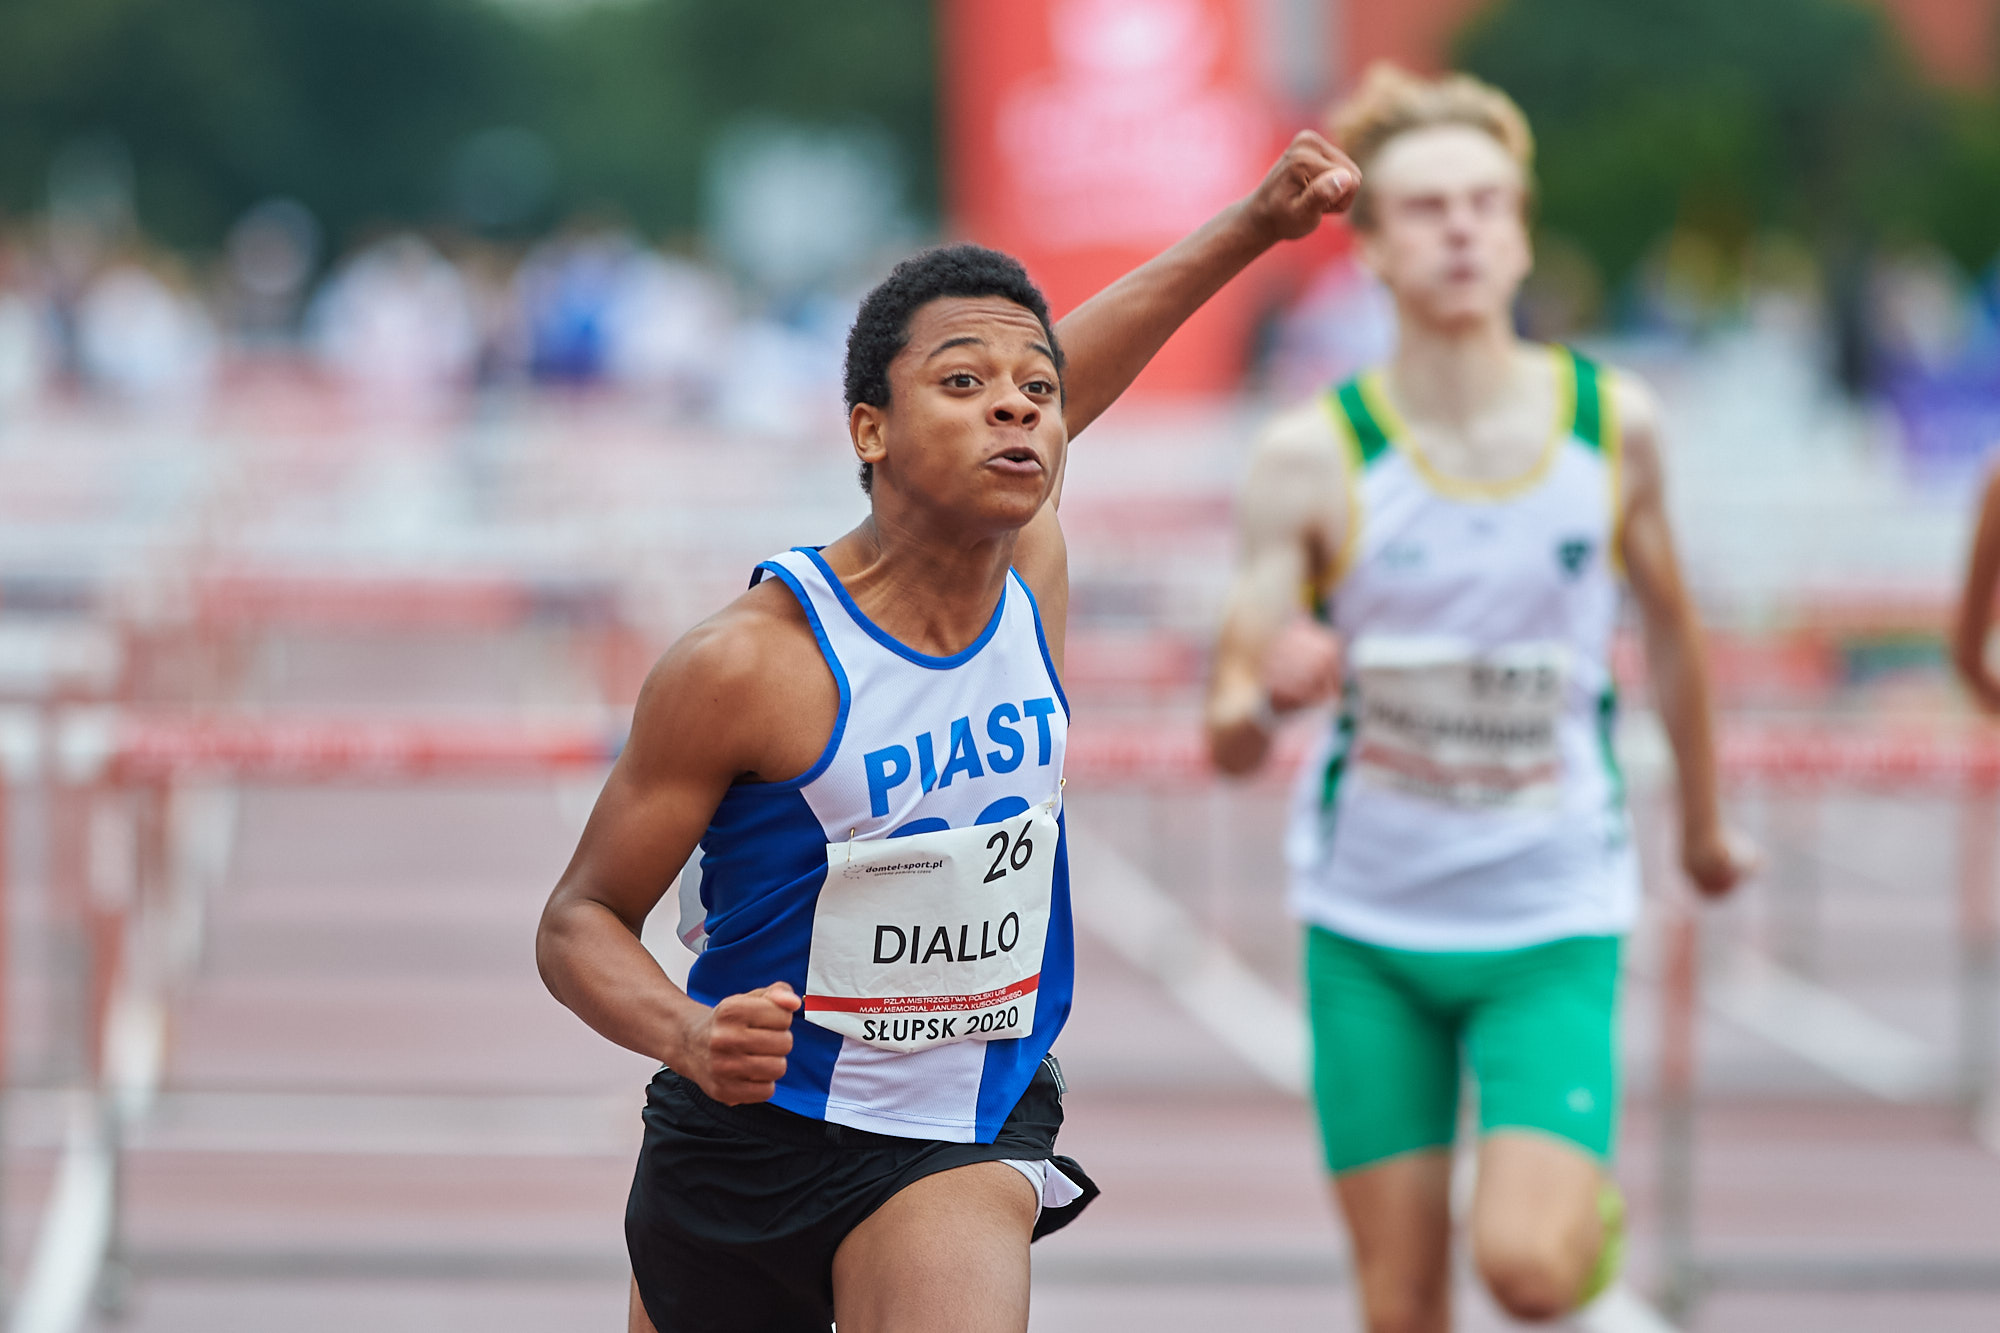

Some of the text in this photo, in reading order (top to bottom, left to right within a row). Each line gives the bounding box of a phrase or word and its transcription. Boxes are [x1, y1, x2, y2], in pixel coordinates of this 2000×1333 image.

[864, 696, 1056, 818] PIAST
[865, 860, 943, 873] domtel-sport.pl
[983, 820, 1034, 884] 26
[872, 911, 1020, 964] DIALLO
[906, 996, 967, 1004] MISTRZOSTWA
[968, 992, 994, 1002] POLSKI
[862, 1006, 1019, 1042] SŁUPSK 2020
